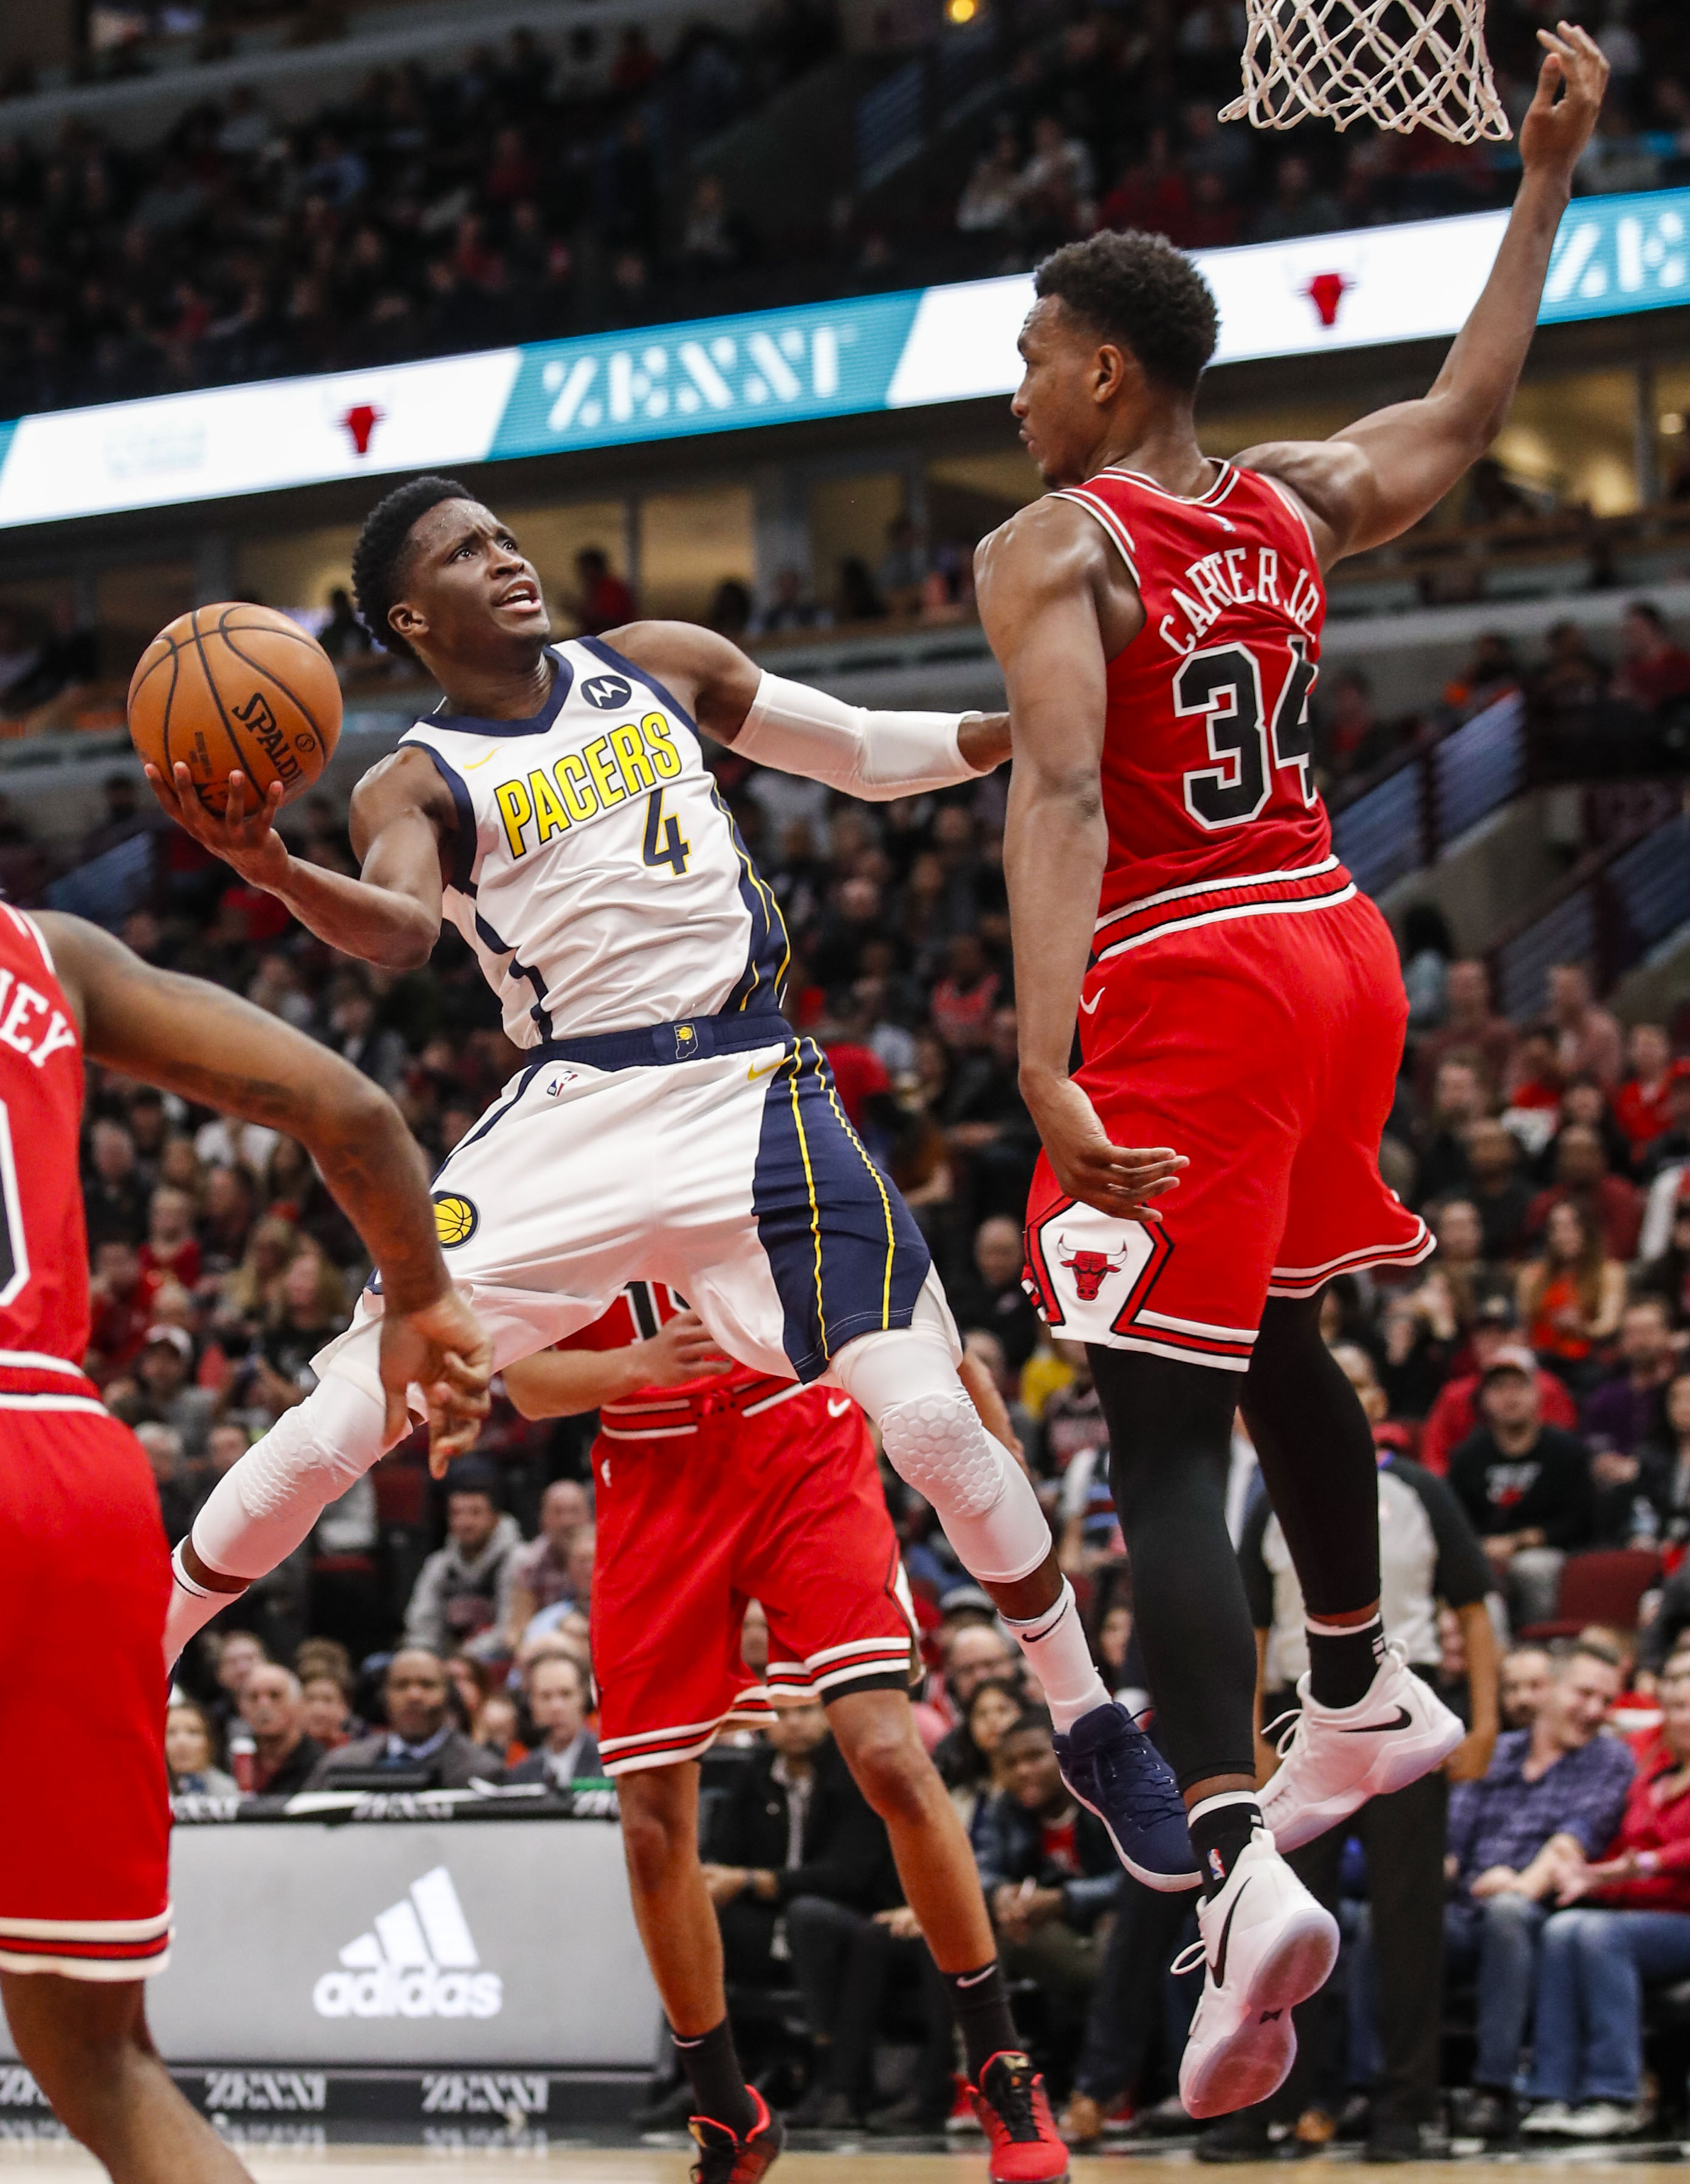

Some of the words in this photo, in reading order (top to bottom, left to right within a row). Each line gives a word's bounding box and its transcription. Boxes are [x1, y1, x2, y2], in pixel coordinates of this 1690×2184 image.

[1158, 547, 1280, 656] CARTER
[493, 711, 682, 860] PACERS
[1172, 634, 1318, 831] 34
[642, 787, 692, 878] 4
[312, 1965, 504, 2019] adidas
